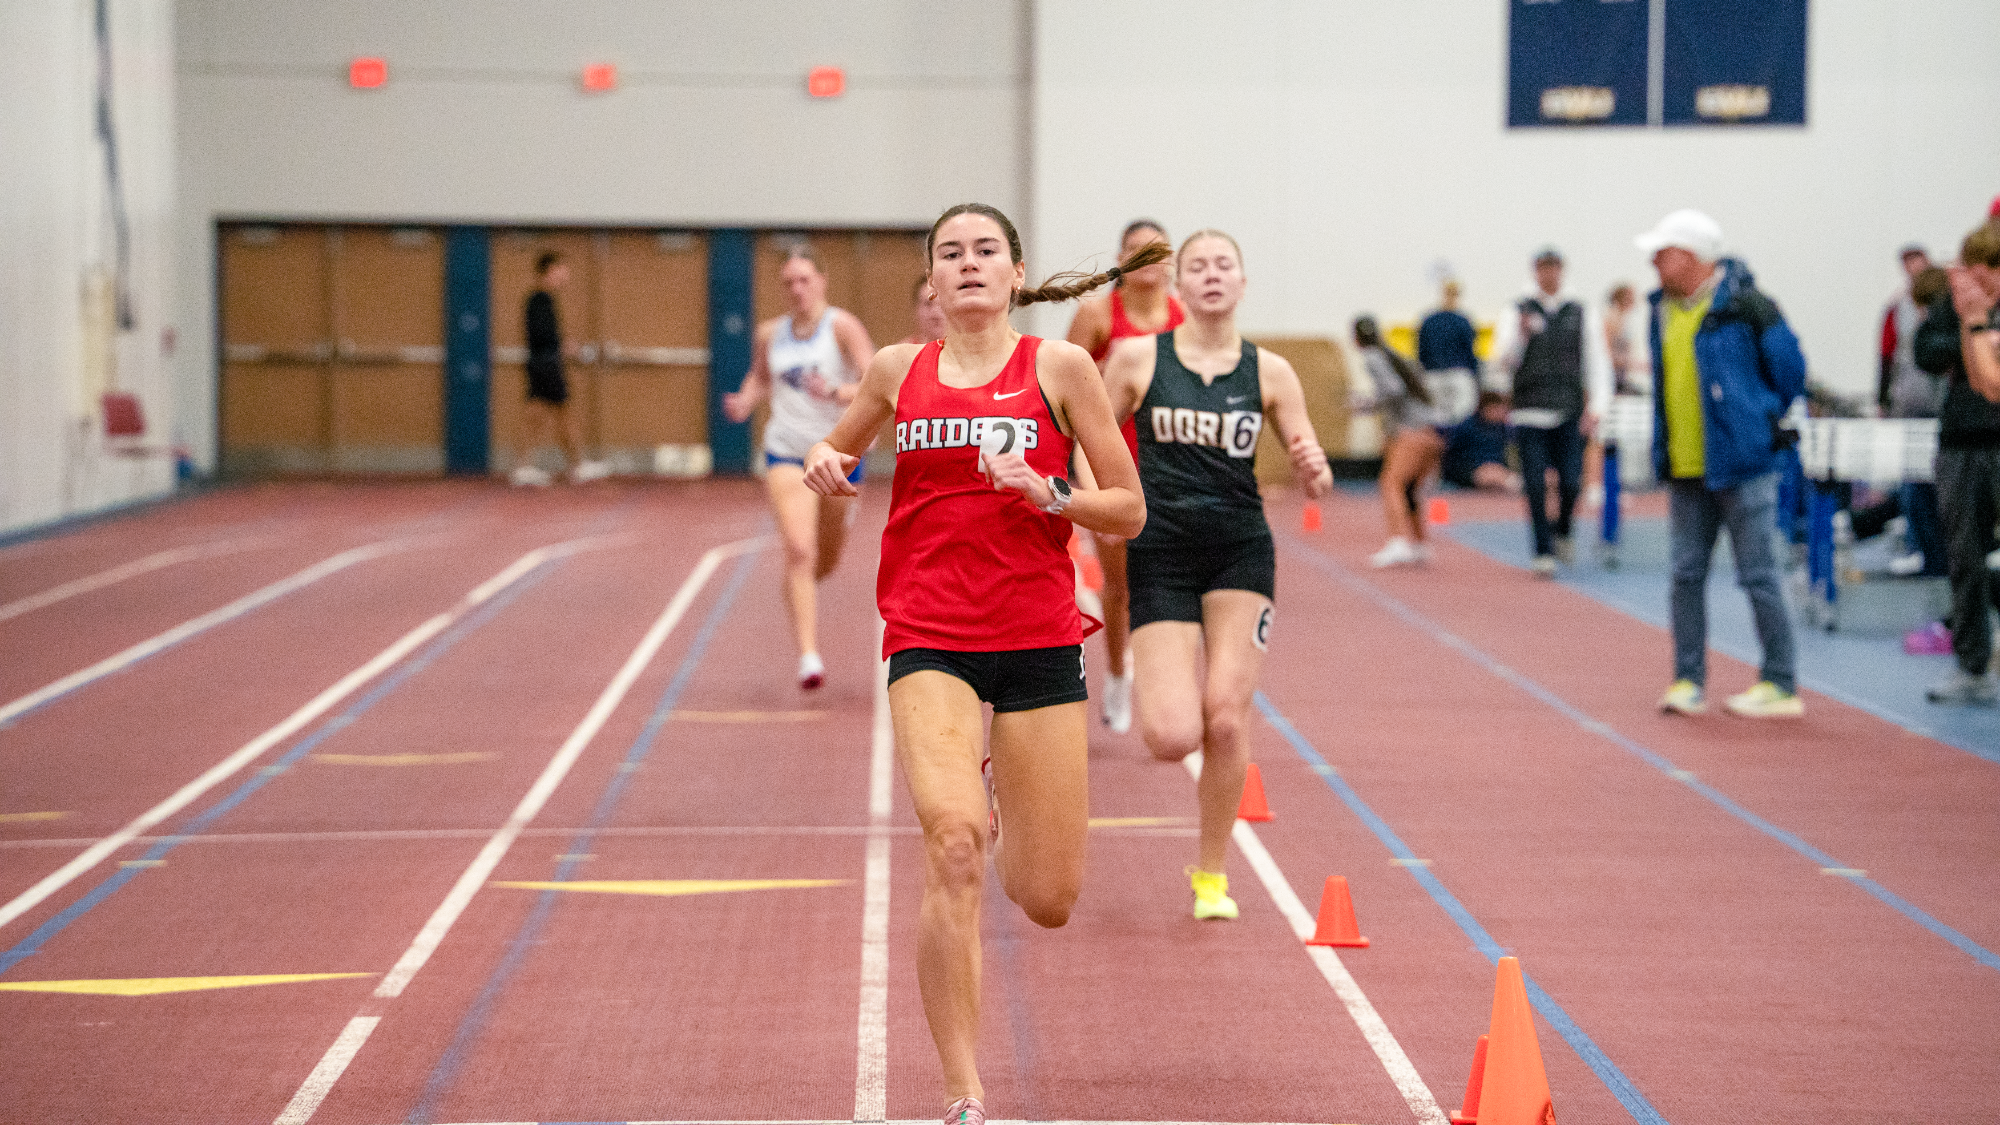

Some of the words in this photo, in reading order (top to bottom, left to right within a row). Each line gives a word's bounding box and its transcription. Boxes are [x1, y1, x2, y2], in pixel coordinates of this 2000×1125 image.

[896, 416, 1039, 454] RAIDES
[992, 421, 1016, 455] 2
[1152, 407, 1232, 449] DOR
[1233, 415, 1255, 450] 6
